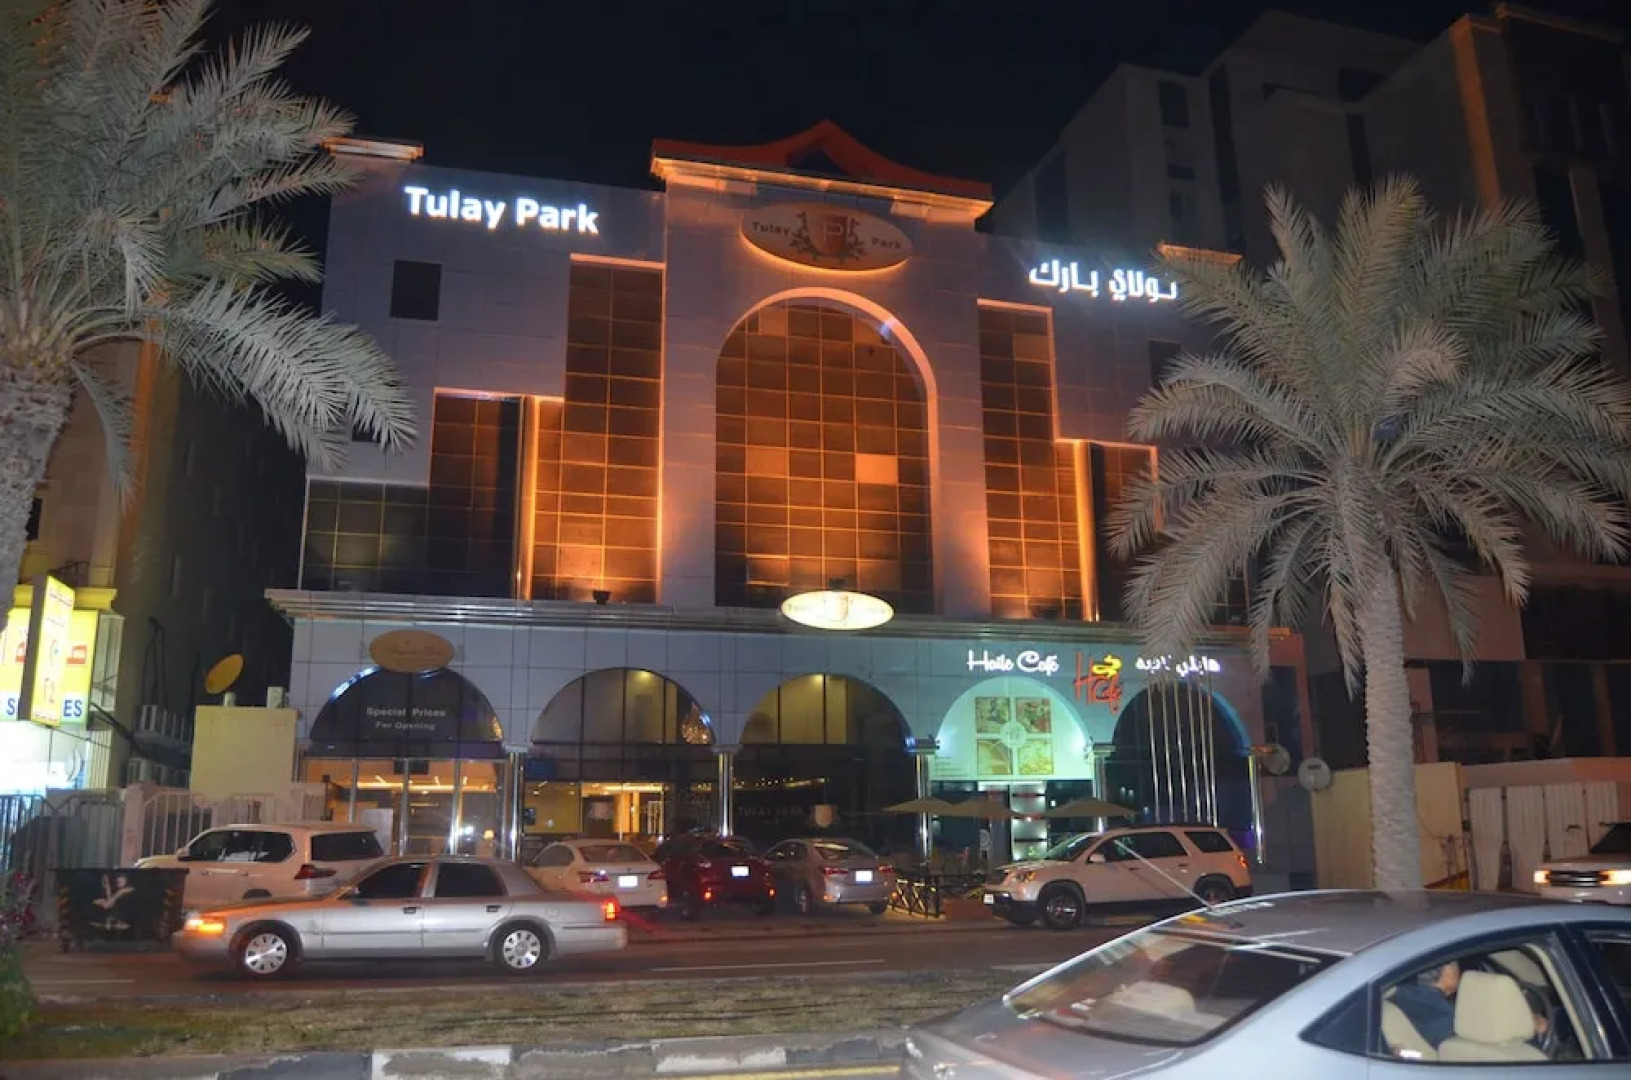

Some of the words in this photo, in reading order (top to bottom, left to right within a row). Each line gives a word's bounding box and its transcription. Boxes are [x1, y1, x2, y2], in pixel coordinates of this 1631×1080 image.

[404, 185, 506, 229] Tulay
[516, 197, 599, 234] Park
[752, 221, 791, 236] Tulay
[871, 236, 902, 249] Park
[1029, 259, 1099, 298] بارك
[366, 706, 407, 717] Special
[412, 707, 447, 717] Prices
